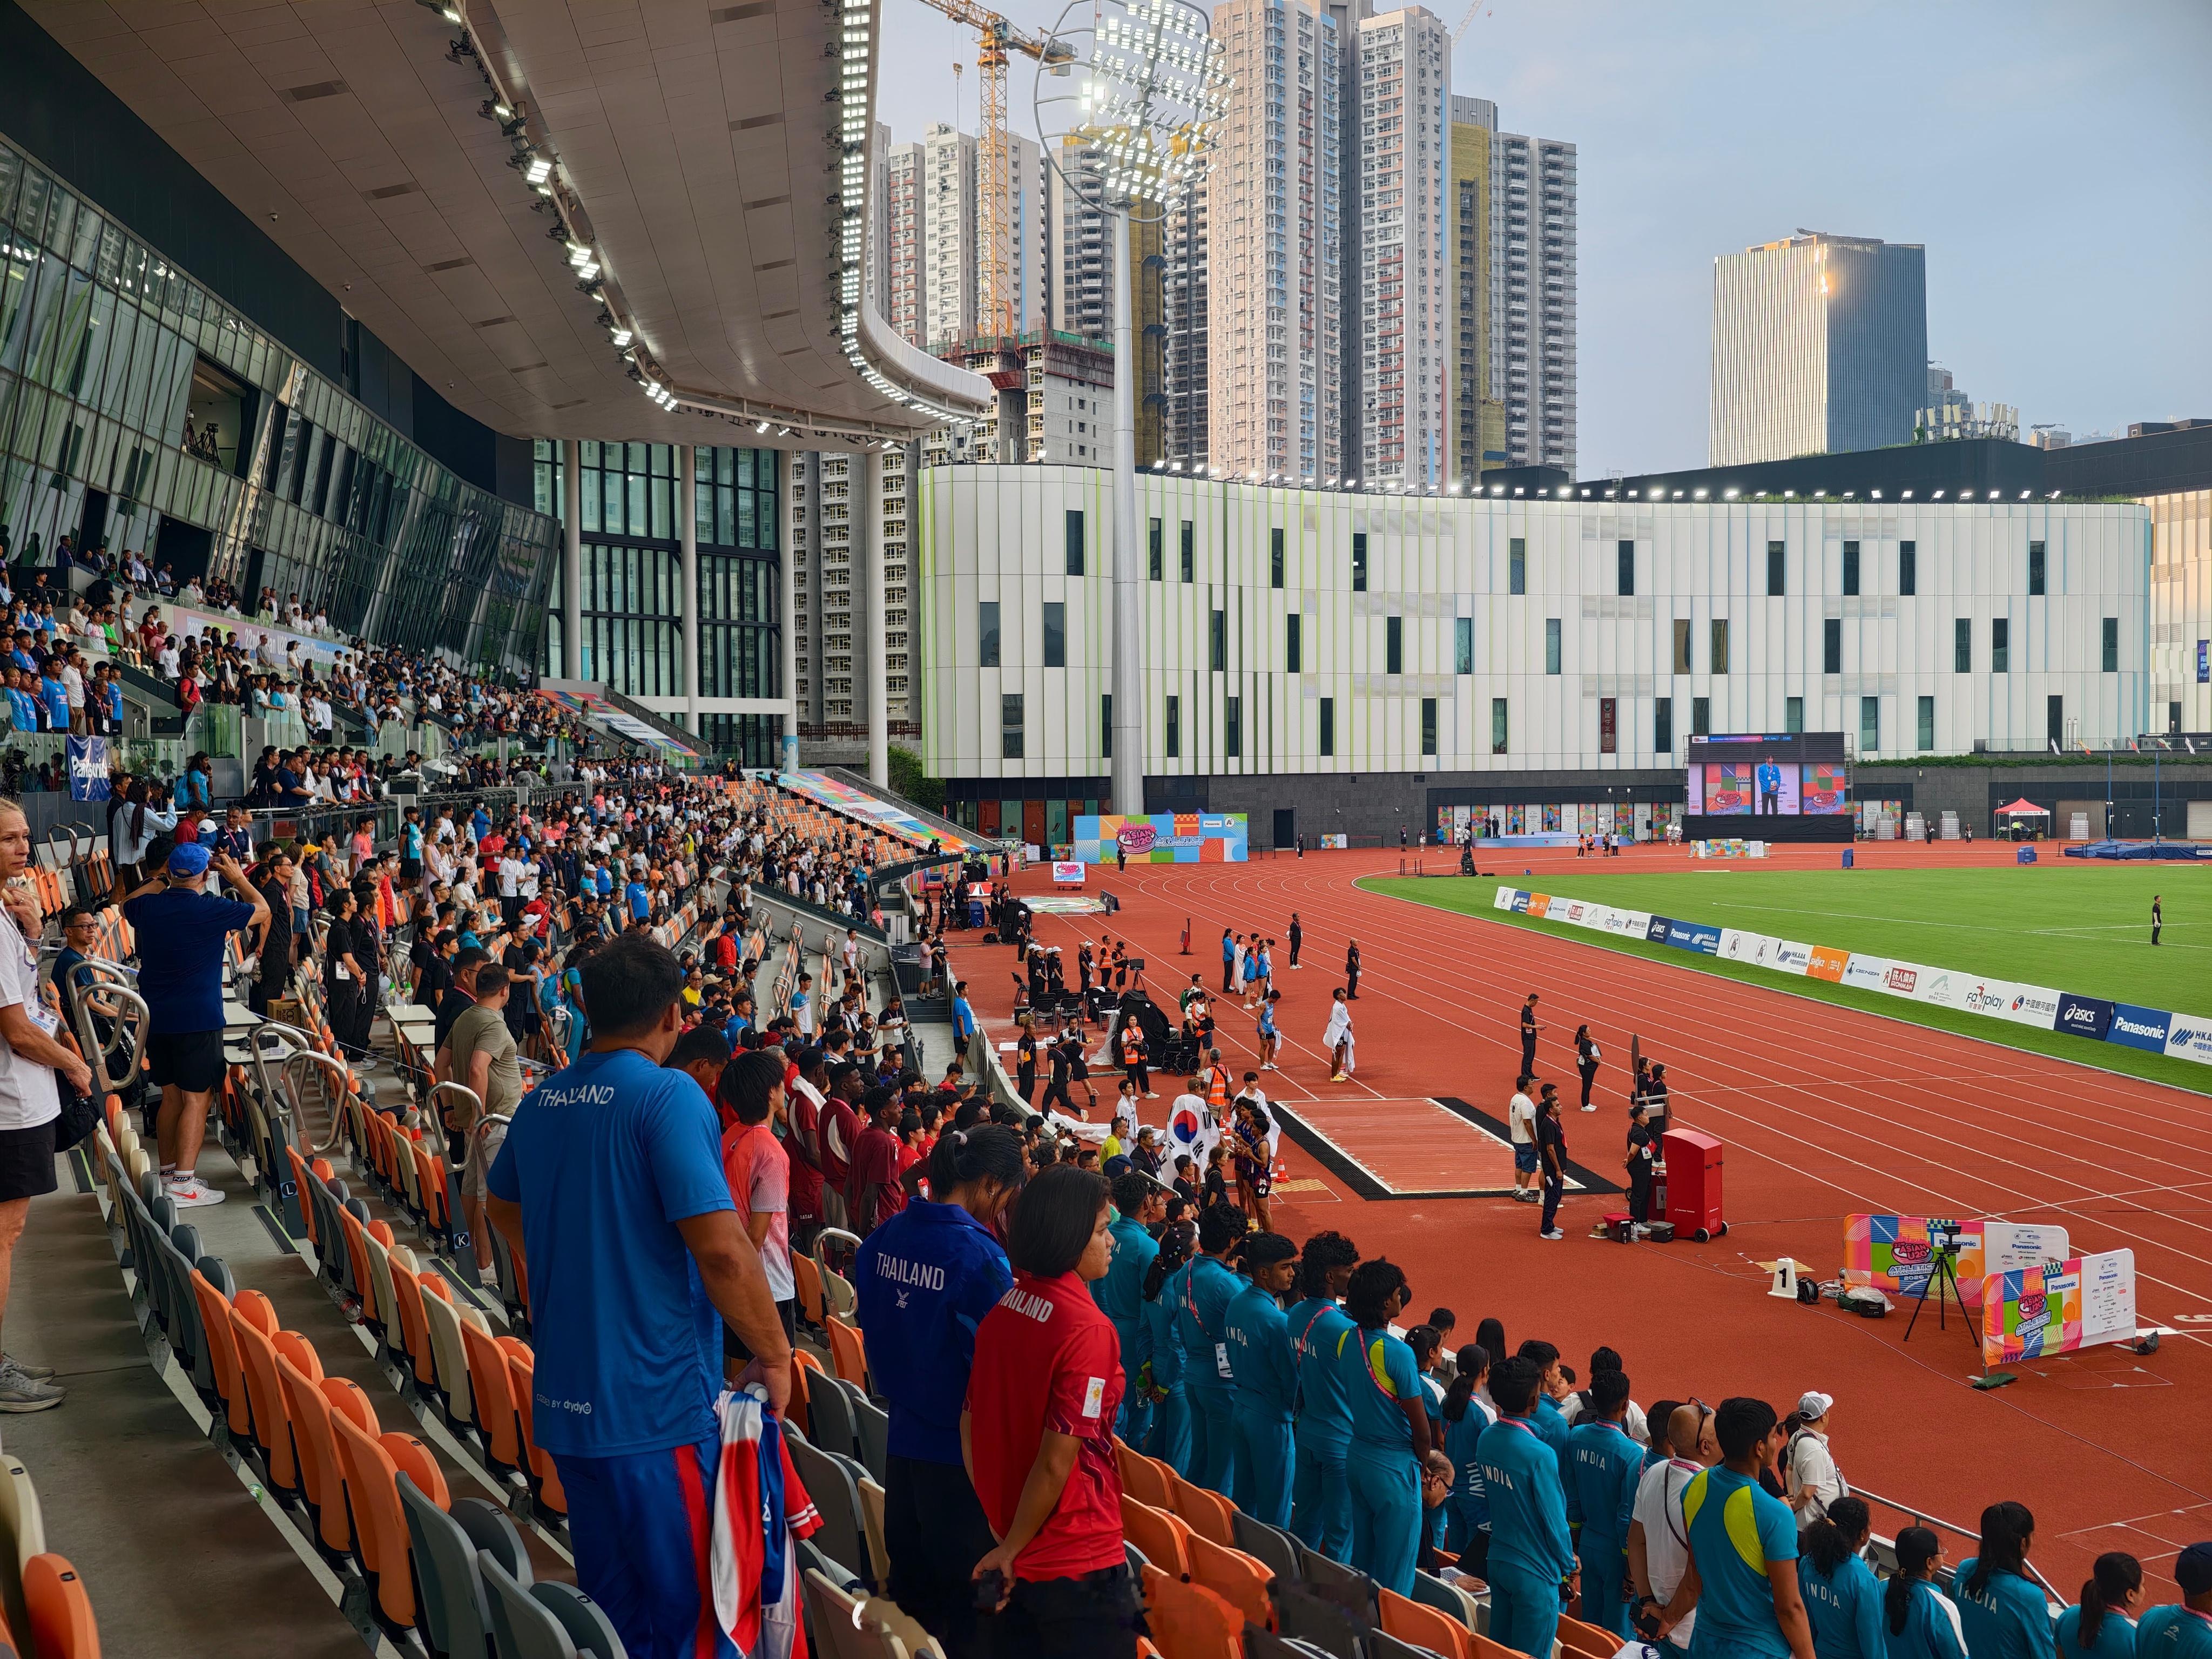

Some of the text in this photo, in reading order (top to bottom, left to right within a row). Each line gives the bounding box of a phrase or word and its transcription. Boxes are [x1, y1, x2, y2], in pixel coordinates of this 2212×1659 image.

[1124, 830, 1152, 841] ASIAN
[1132, 837, 1152, 847] U20
[1670, 928, 1690, 941] Panasonic
[1810, 957, 1825, 967] SHOKZ
[1856, 968, 1879, 976] DENZA
[1891, 981, 1913, 990] IRONMAN
[1966, 989, 2005, 1011] fairplay
[2074, 1008, 2095, 1023] asics
[2115, 1016, 2165, 1040] Panasonic
[286, 1184, 294, 1195] L
[458, 1235, 466, 1246] K
[1899, 1244, 1926, 1254] ASIAN
[1906, 1251, 1927, 1260] U20
[876, 1252, 945, 1291] THAILAND
[1890, 1263, 1936, 1272] ATHLETICS
[1779, 1267, 1787, 1288] 1
[2051, 1280, 2076, 1291] Panasonic
[2024, 1295, 2043, 1309] ASIAN
[2030, 1301, 2043, 1313] U20
[2017, 1313, 2050, 1331] ATHLETICS
[1226, 1326, 1249, 1348] INDIA
[2027, 1328, 2041, 1337] 2026
[551, 1400, 562, 1408] BY
[563, 1399, 592, 1415] drydye
[1576, 1448, 1606, 1472] INDIA
[1481, 1464, 1513, 1490] INDIA
[1805, 1581, 1840, 1610] INDIA
